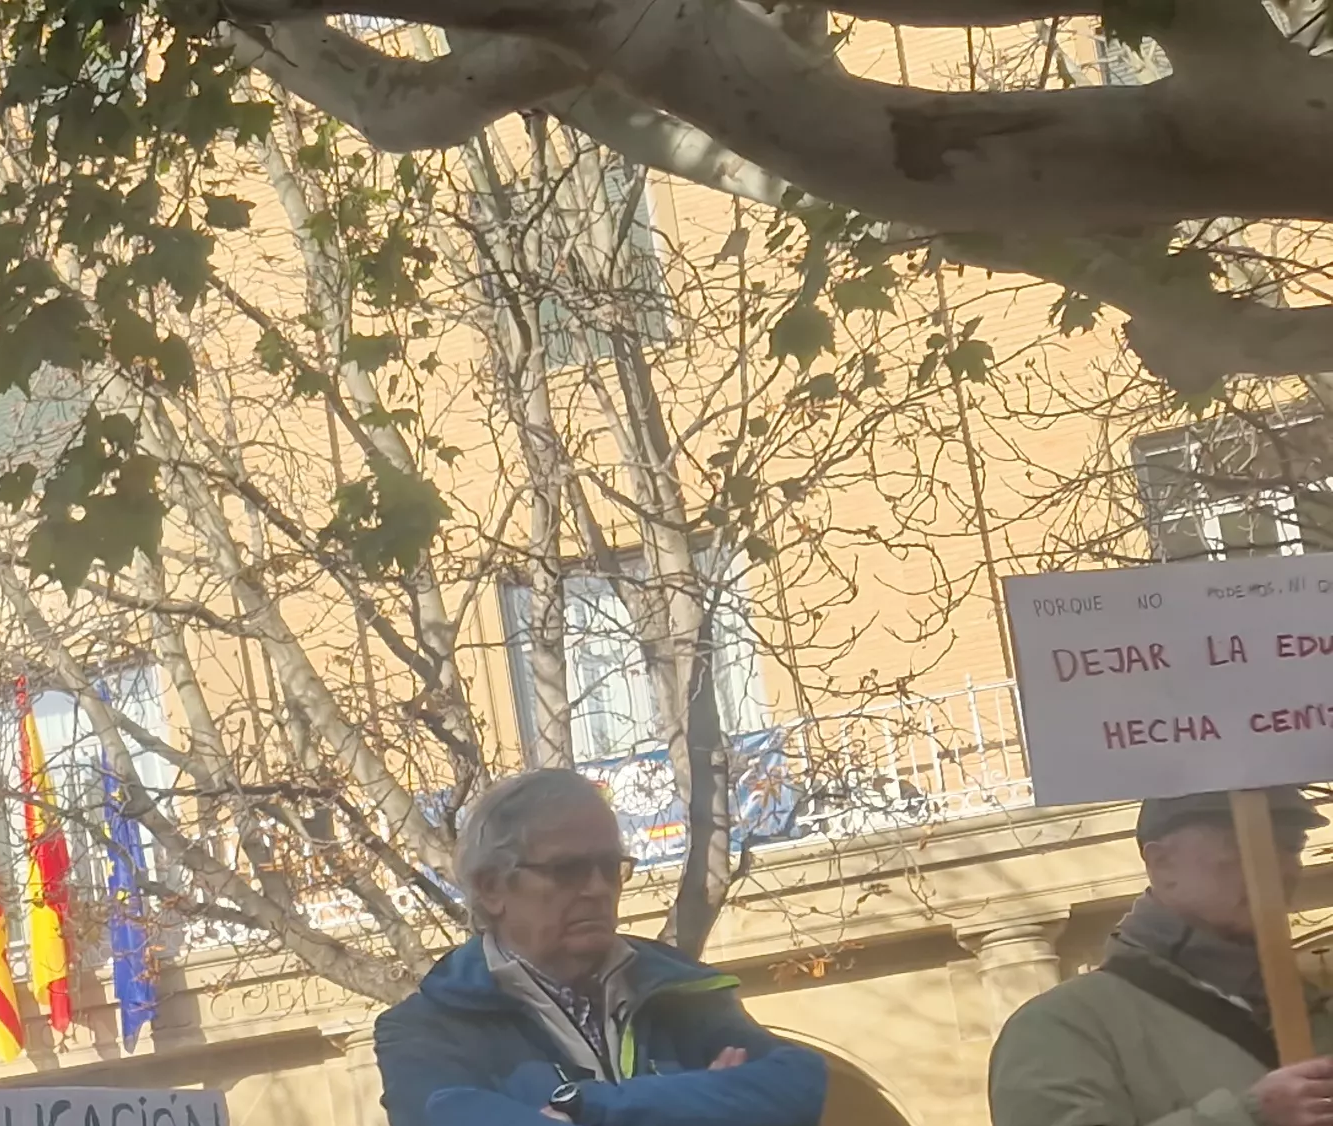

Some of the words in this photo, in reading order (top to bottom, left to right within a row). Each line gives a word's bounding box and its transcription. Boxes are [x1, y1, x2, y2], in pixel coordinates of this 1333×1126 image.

[1033, 595, 1103, 618] PORQUE
[1137, 593, 1162, 611] NO
[1052, 643, 1171, 683] DEJAR
[1207, 634, 1248, 667] LA
[1103, 714, 1222, 750] HECHA
